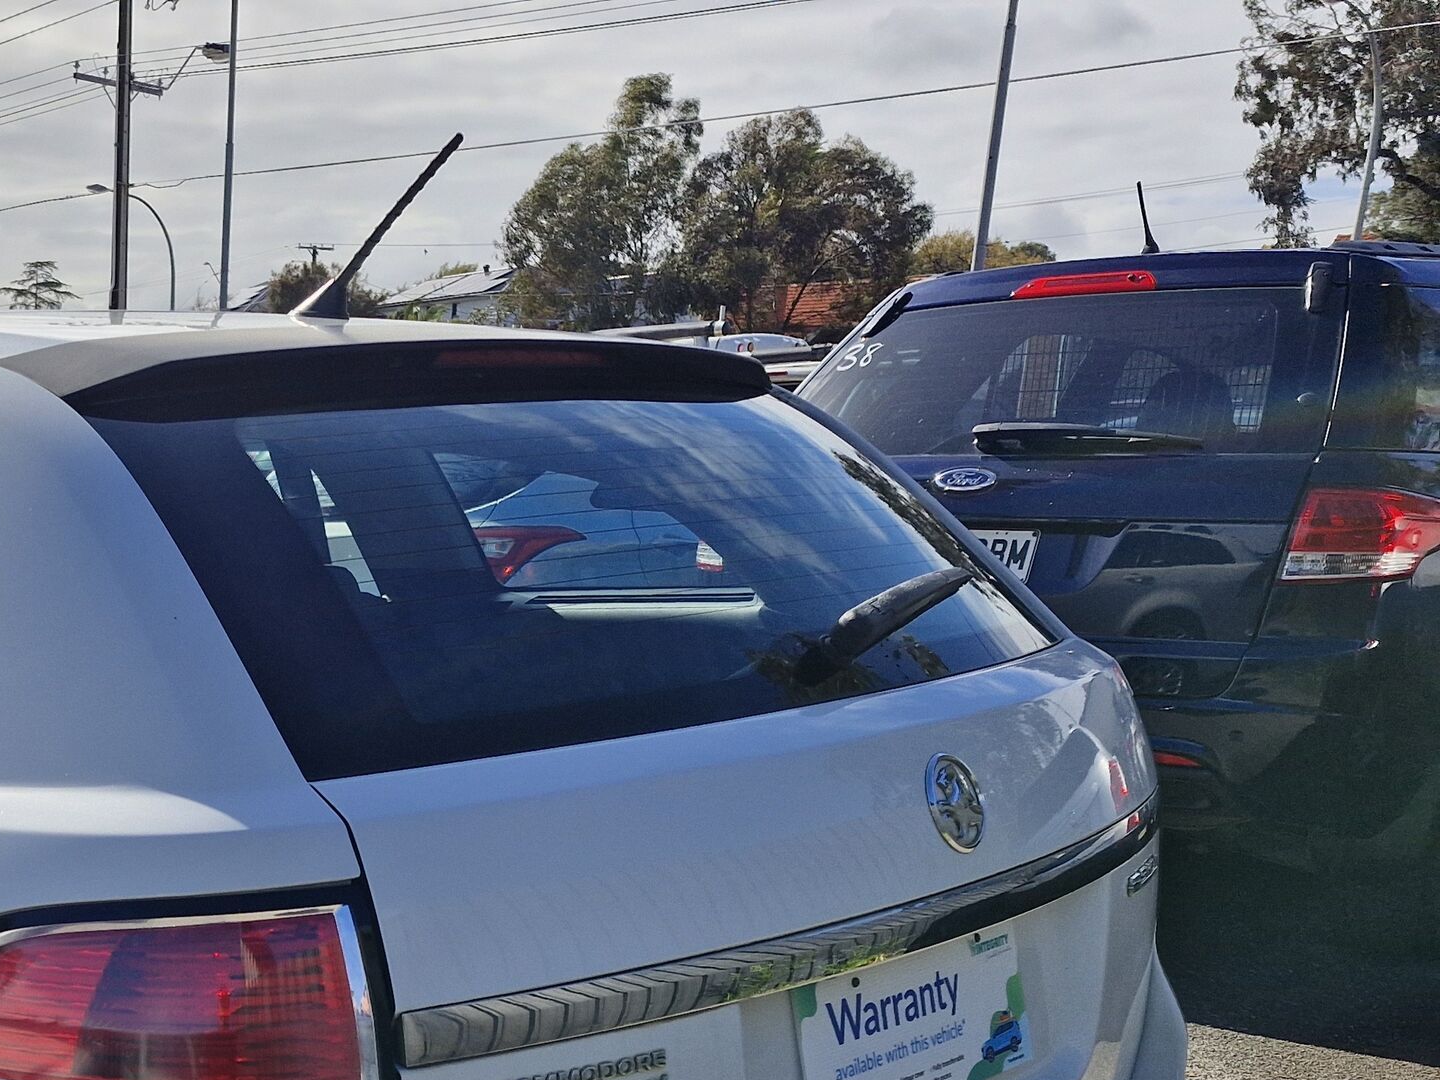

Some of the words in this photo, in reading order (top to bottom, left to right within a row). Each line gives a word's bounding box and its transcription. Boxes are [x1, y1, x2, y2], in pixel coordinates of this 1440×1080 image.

[836, 343, 884, 371] 38
[947, 470, 982, 486] Ford
[825, 971, 958, 1046] Warranty
[885, 1044, 909, 1063] with
[910, 1034, 929, 1055] this
